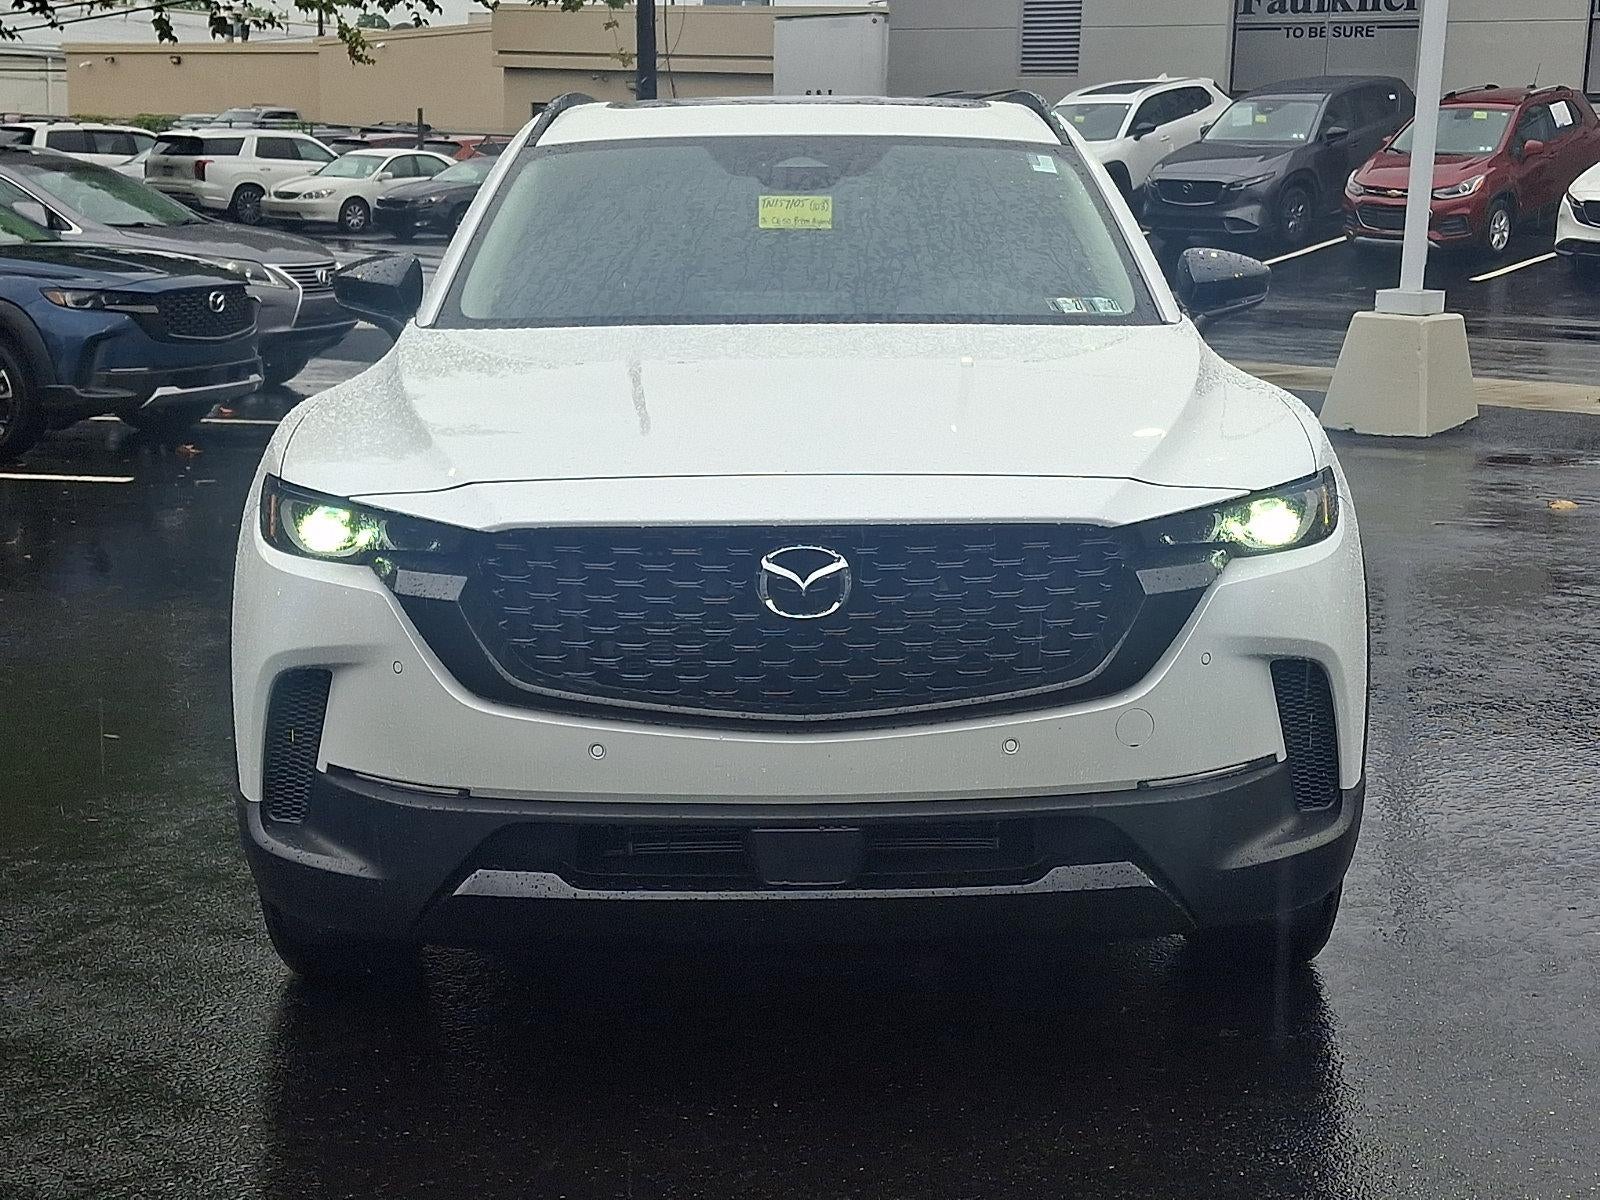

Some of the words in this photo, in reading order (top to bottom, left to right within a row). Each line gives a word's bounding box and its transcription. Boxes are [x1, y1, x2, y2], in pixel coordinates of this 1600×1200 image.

[1285, 27, 1304, 38] TO
[1308, 26, 1327, 38] BE
[1332, 25, 1375, 38] SURE
